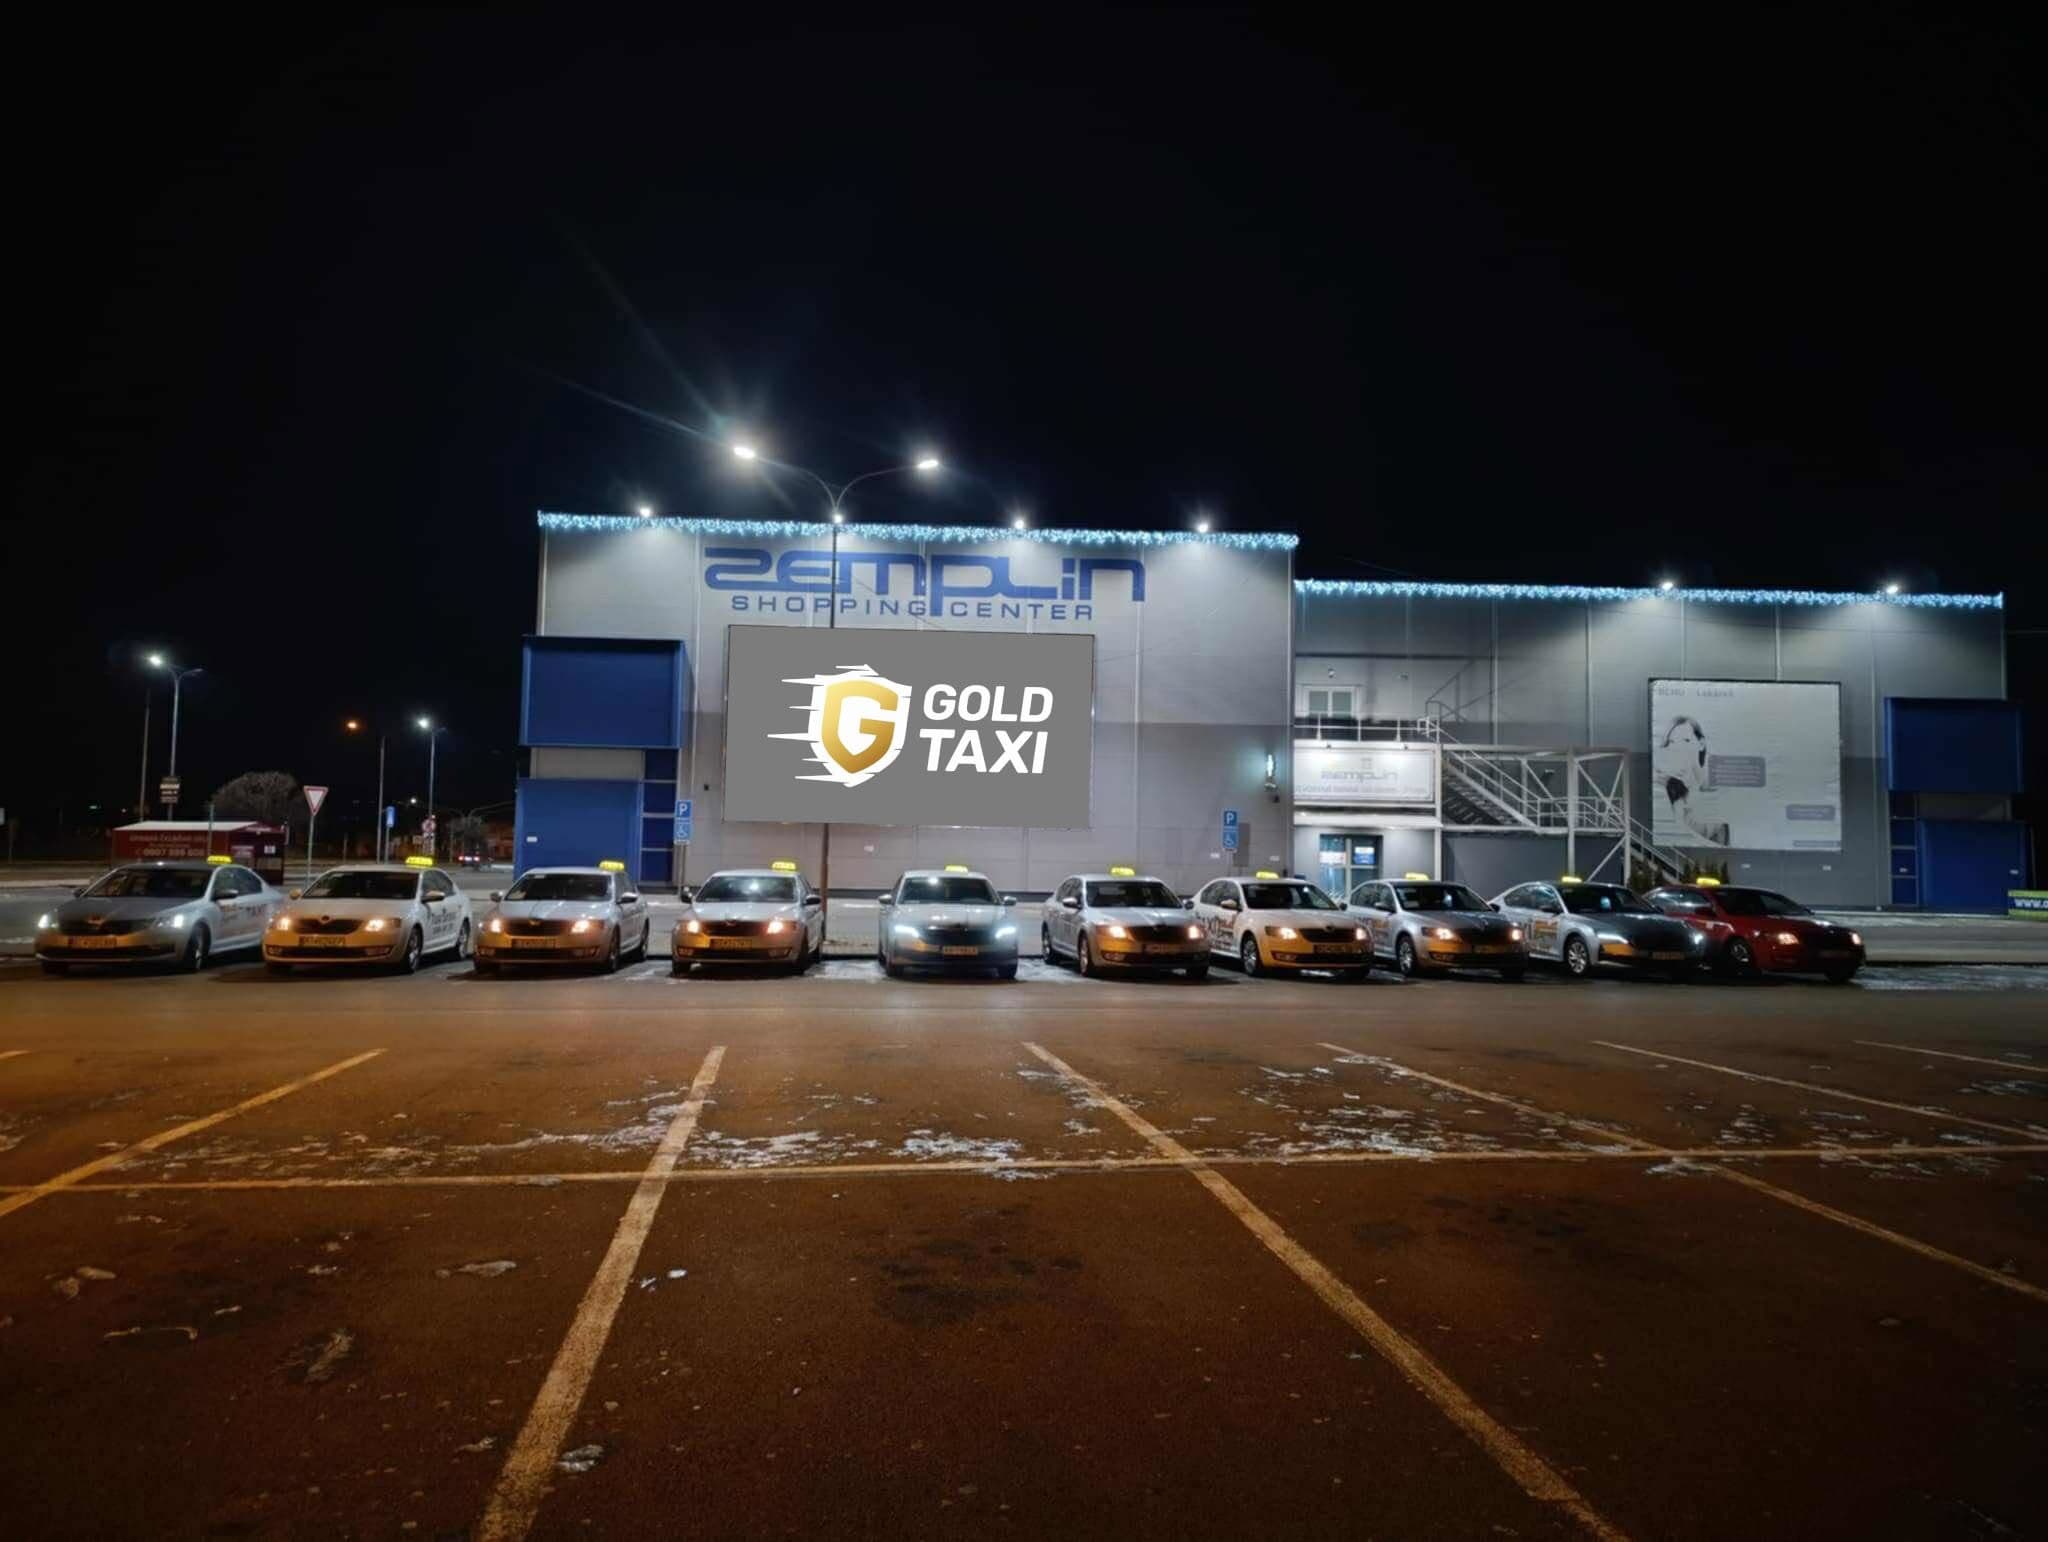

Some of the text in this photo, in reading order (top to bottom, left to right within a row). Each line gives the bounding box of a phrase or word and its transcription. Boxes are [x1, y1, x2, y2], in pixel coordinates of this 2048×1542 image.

[731, 595, 1092, 620] SHOPPING CENTER
[679, 803, 688, 816] P
[1226, 812, 1234, 824] P
